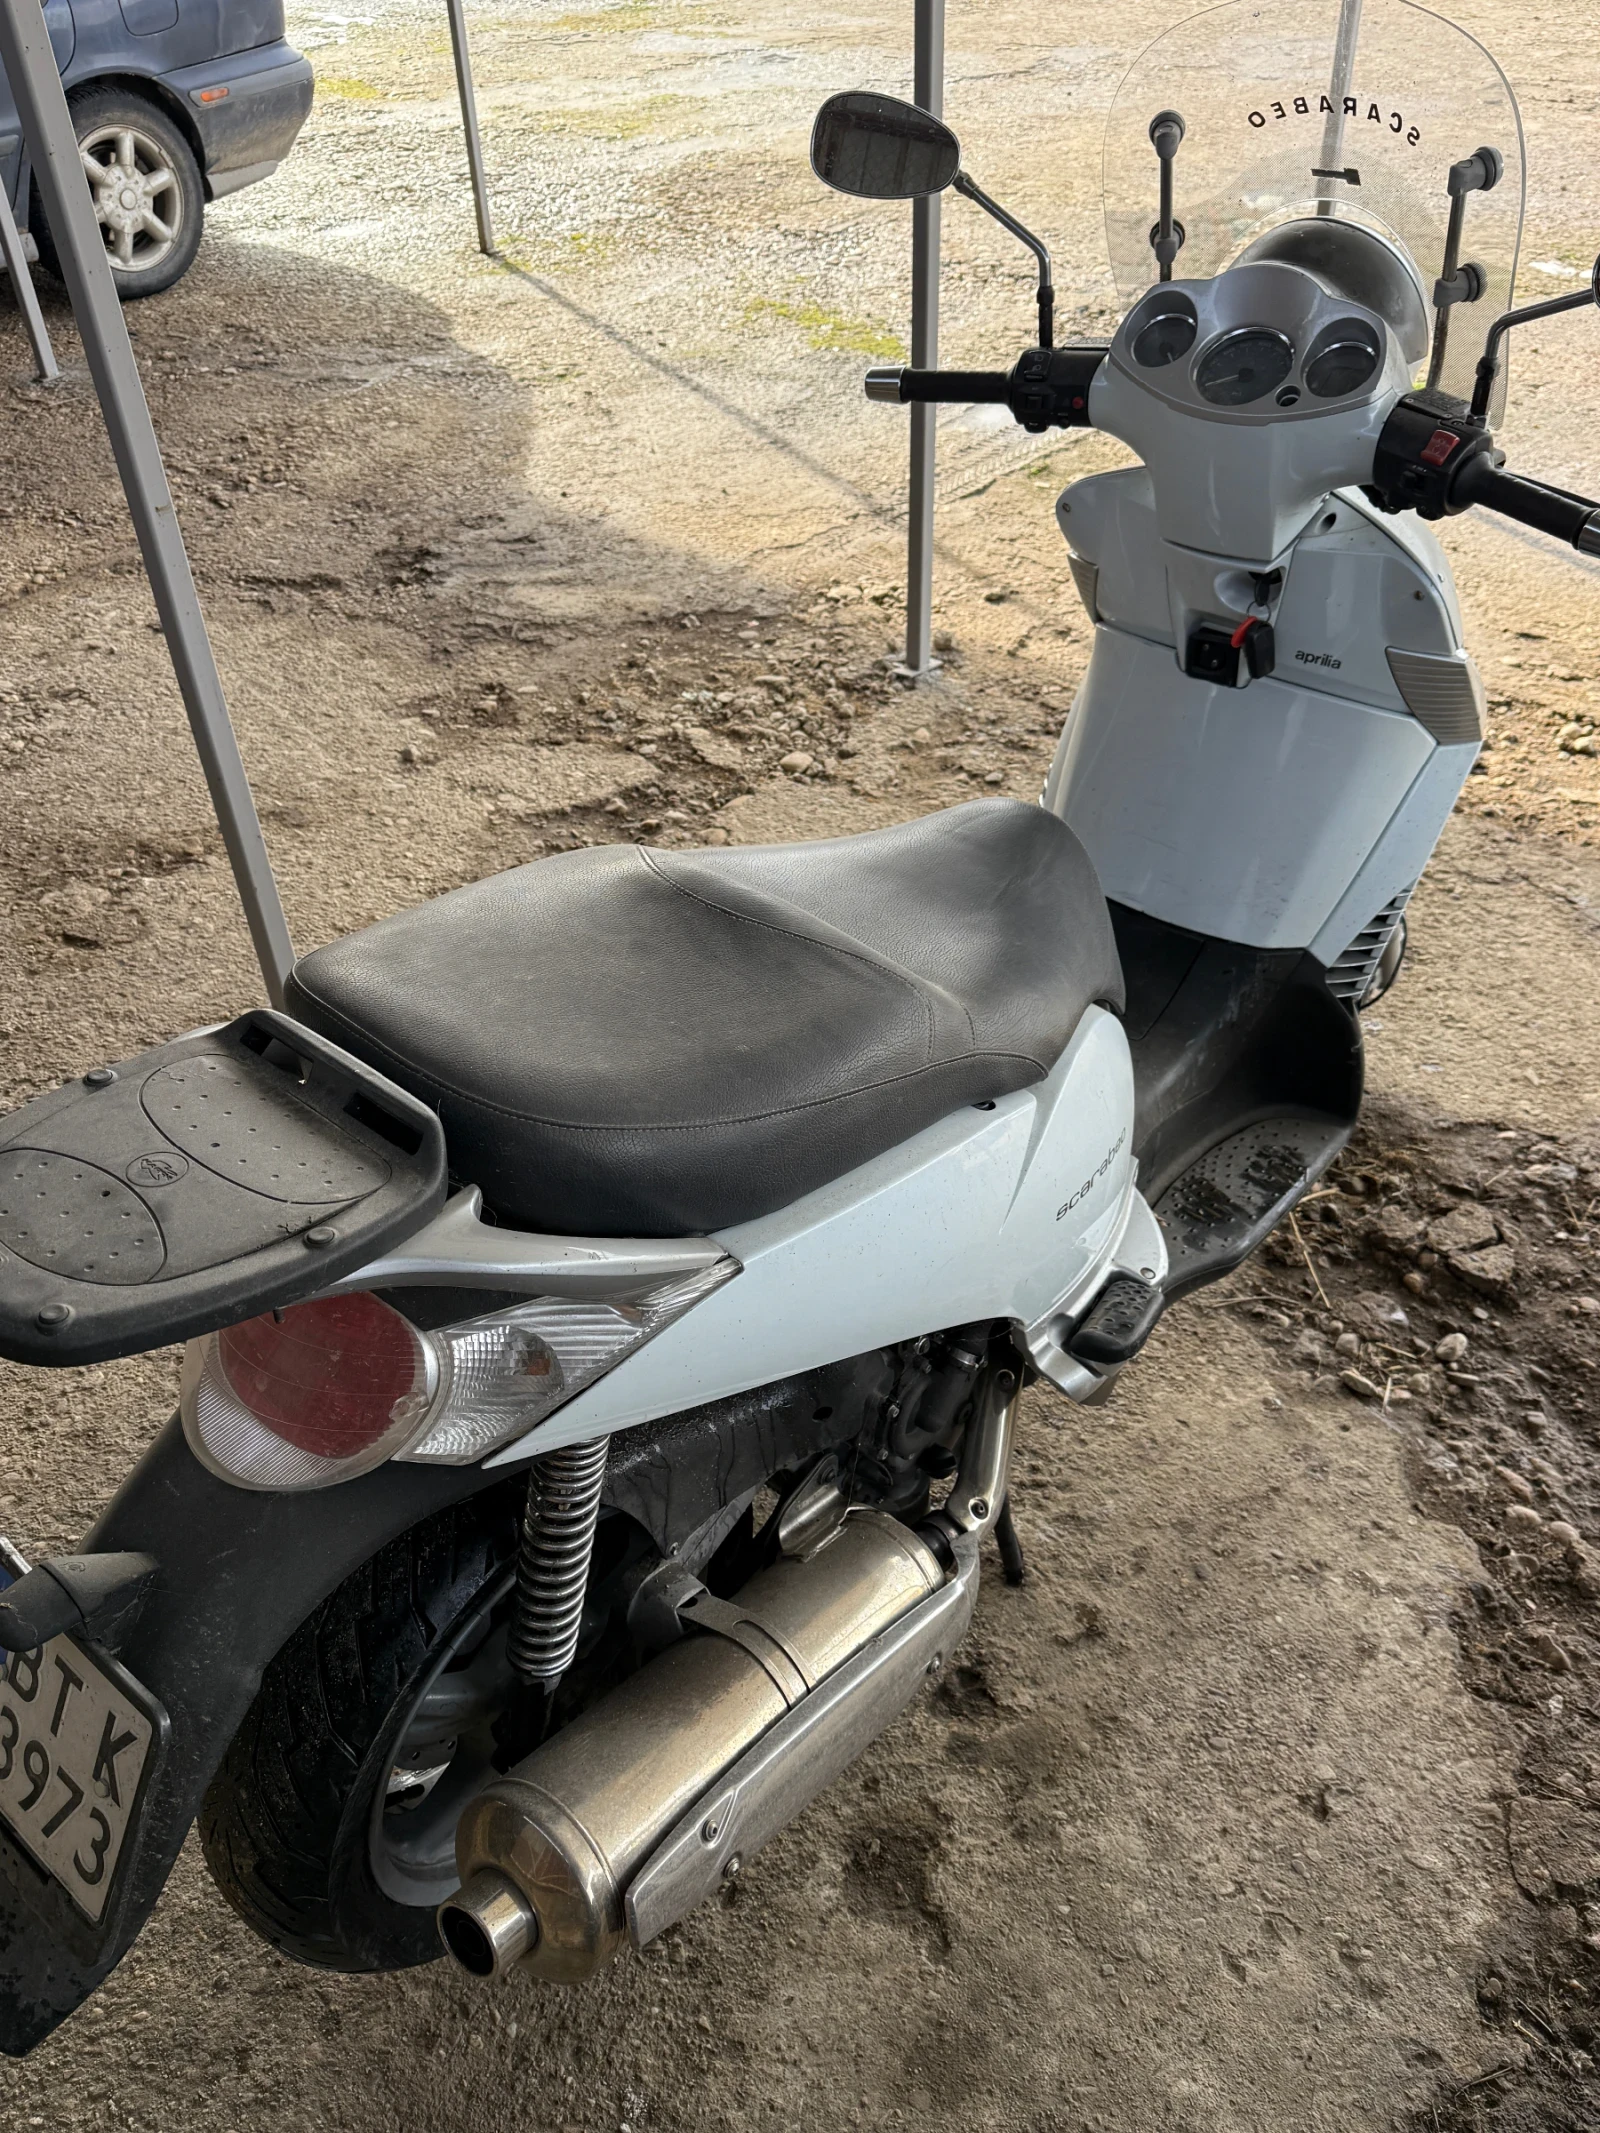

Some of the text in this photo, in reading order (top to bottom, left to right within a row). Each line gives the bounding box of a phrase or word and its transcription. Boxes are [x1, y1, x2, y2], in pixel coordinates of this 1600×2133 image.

[1295, 650, 1342, 669] aprilia
[1056, 1127, 1126, 1221] scarabeo
[0, 1705, 111, 1885] 3973
